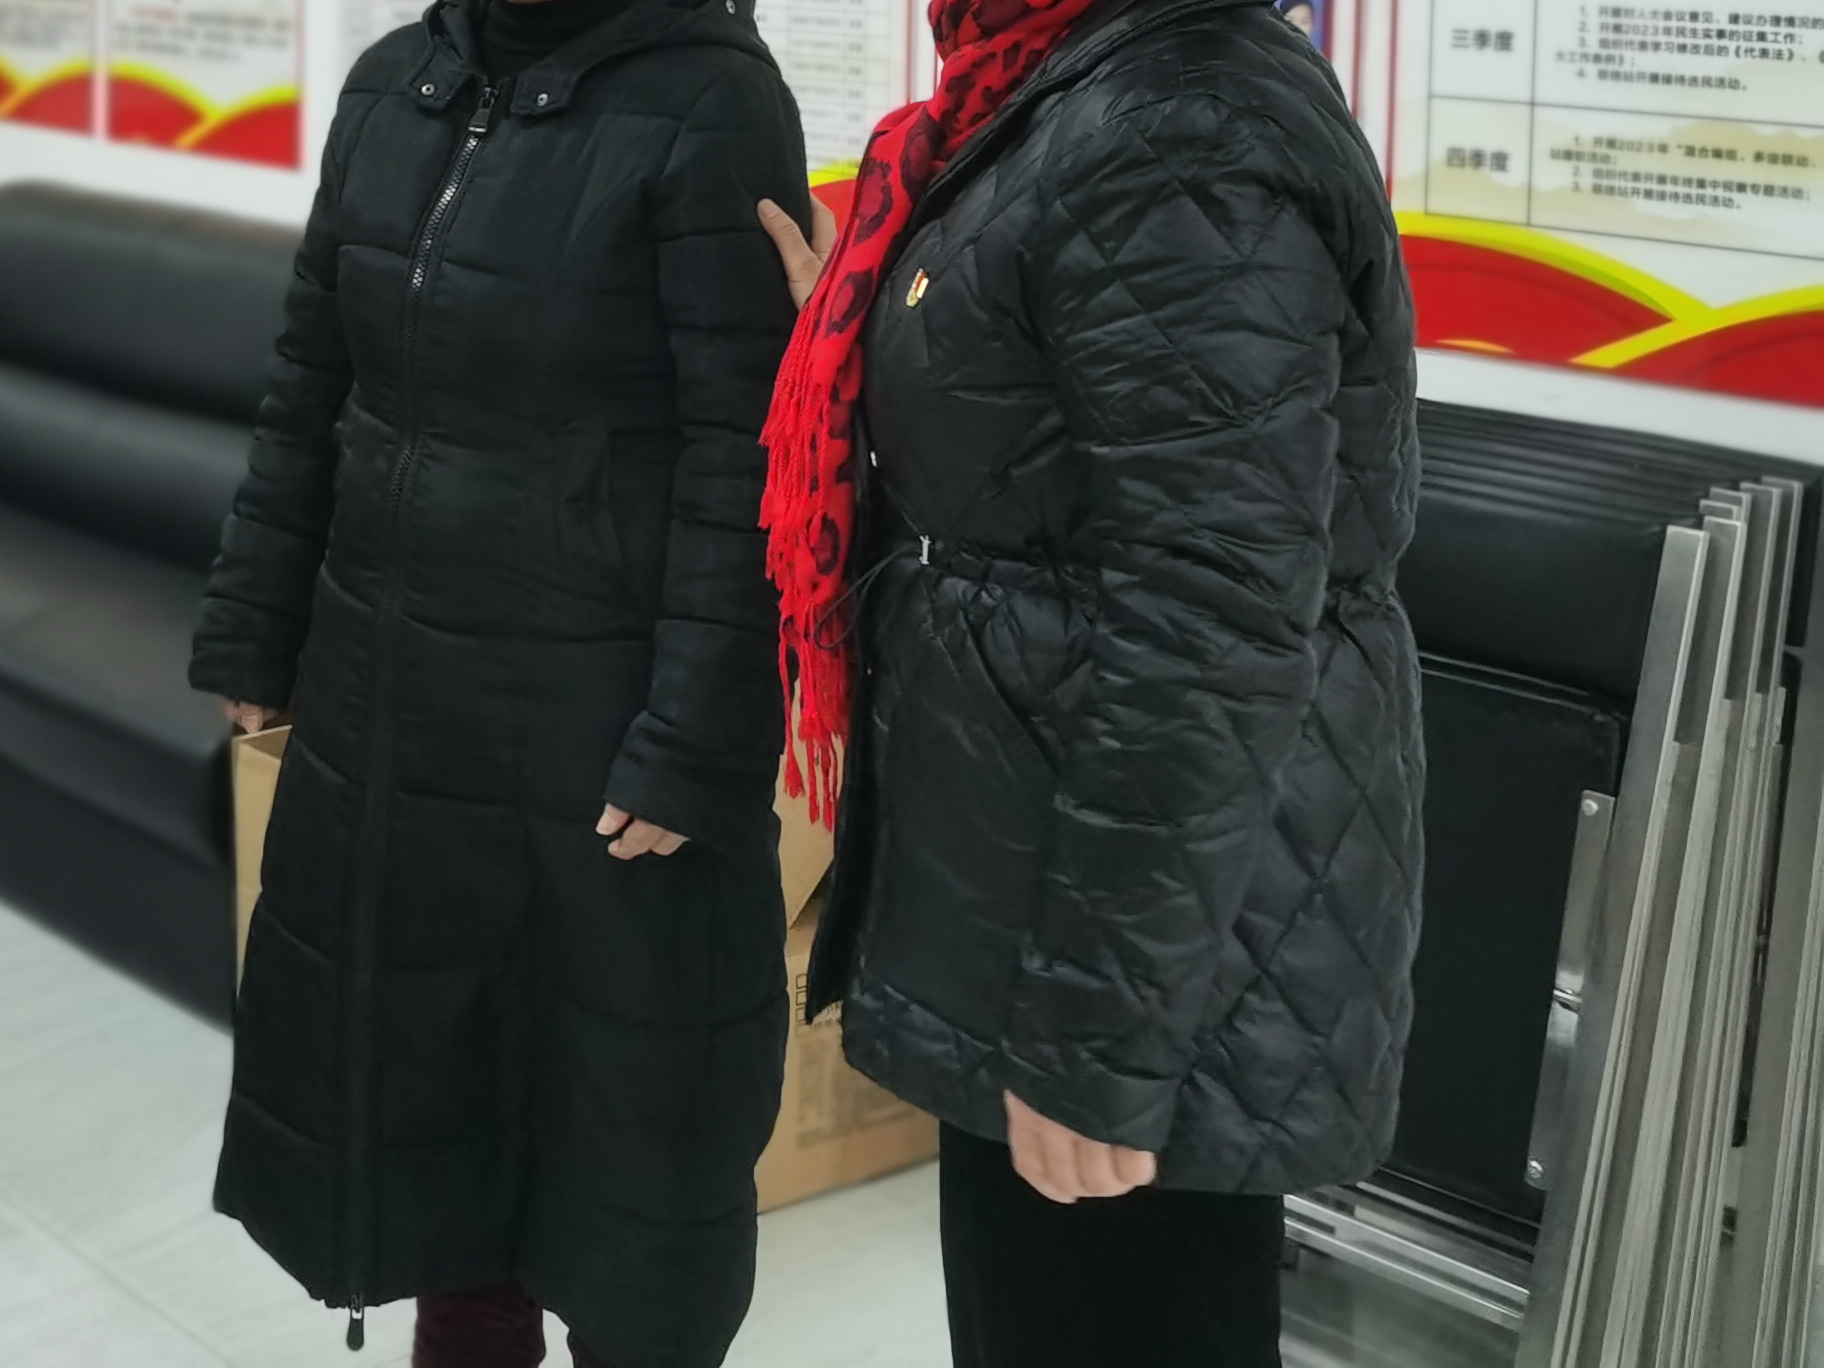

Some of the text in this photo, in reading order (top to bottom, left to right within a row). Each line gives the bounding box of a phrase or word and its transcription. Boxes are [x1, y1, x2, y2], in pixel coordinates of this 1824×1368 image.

[1450, 28, 1515, 53] 三季度
[1445, 146, 1511, 174] 四季度
